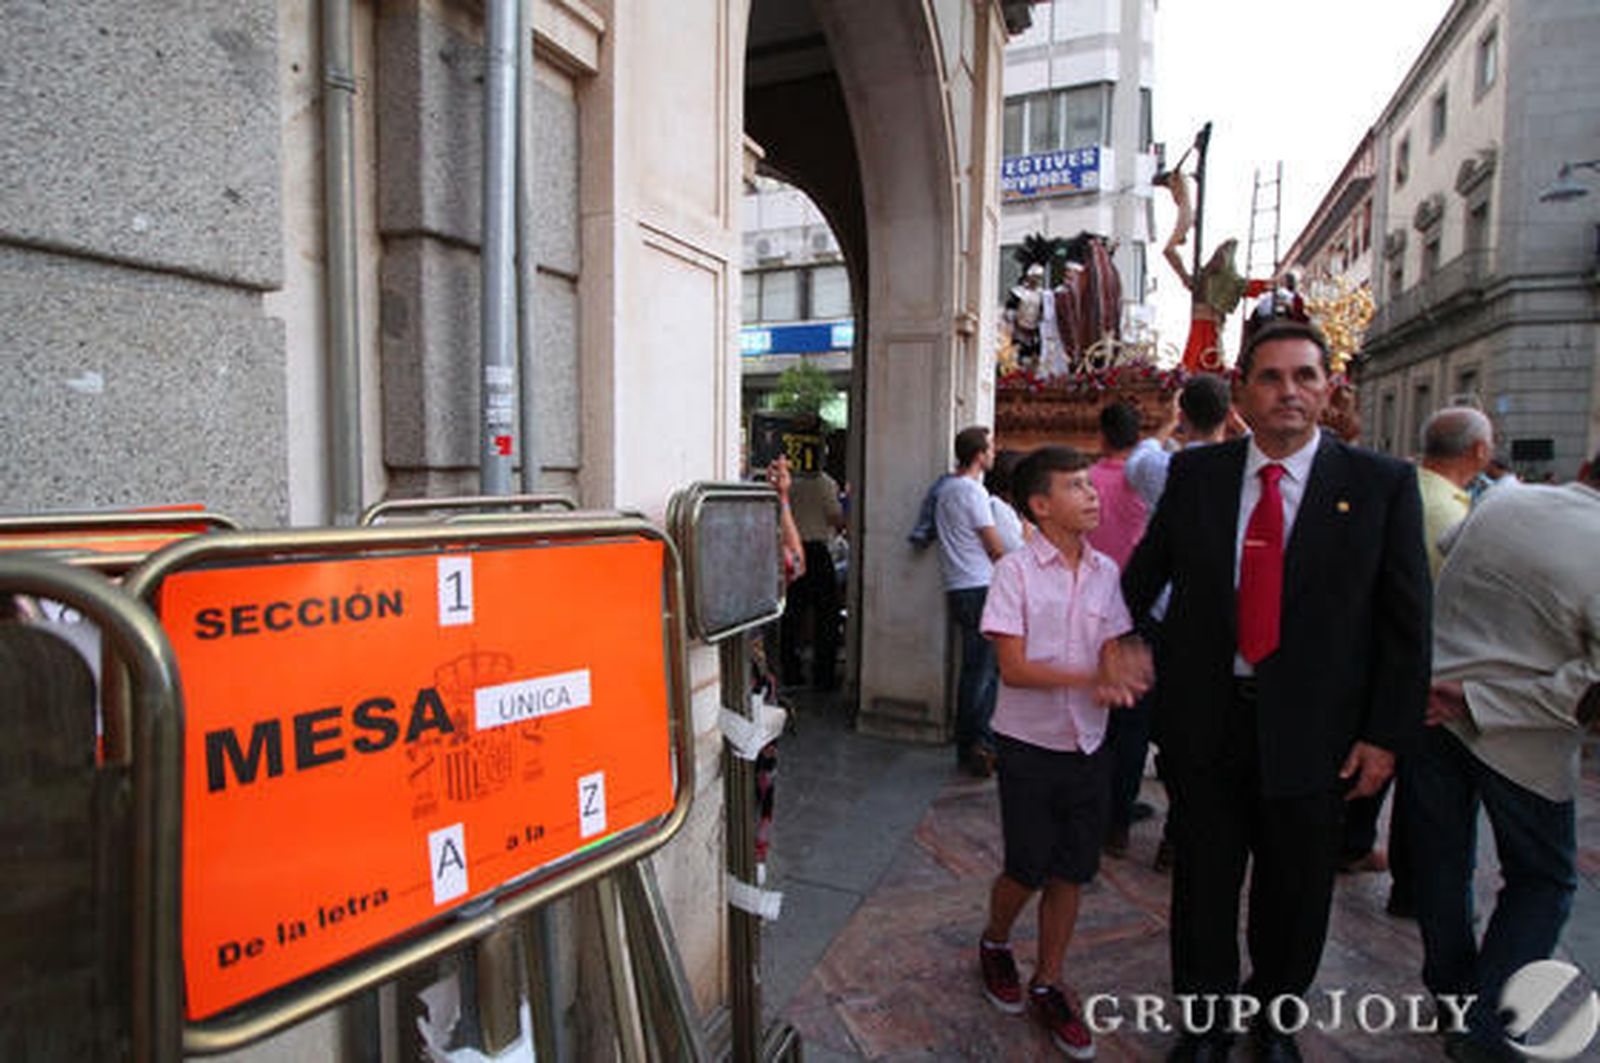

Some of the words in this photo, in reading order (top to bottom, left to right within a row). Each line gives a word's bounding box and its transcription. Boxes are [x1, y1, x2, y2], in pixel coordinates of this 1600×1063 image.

[194, 584, 403, 639] SECCIÓN
[446, 571, 469, 612] 1
[205, 687, 455, 793] MESA
[217, 938, 264, 968] De
[277, 923, 306, 945] la
[318, 888, 390, 930] letra
[436, 838, 465, 879] A
[505, 834, 519, 851] a
[525, 823, 546, 844] la
[582, 783, 601, 817] Z
